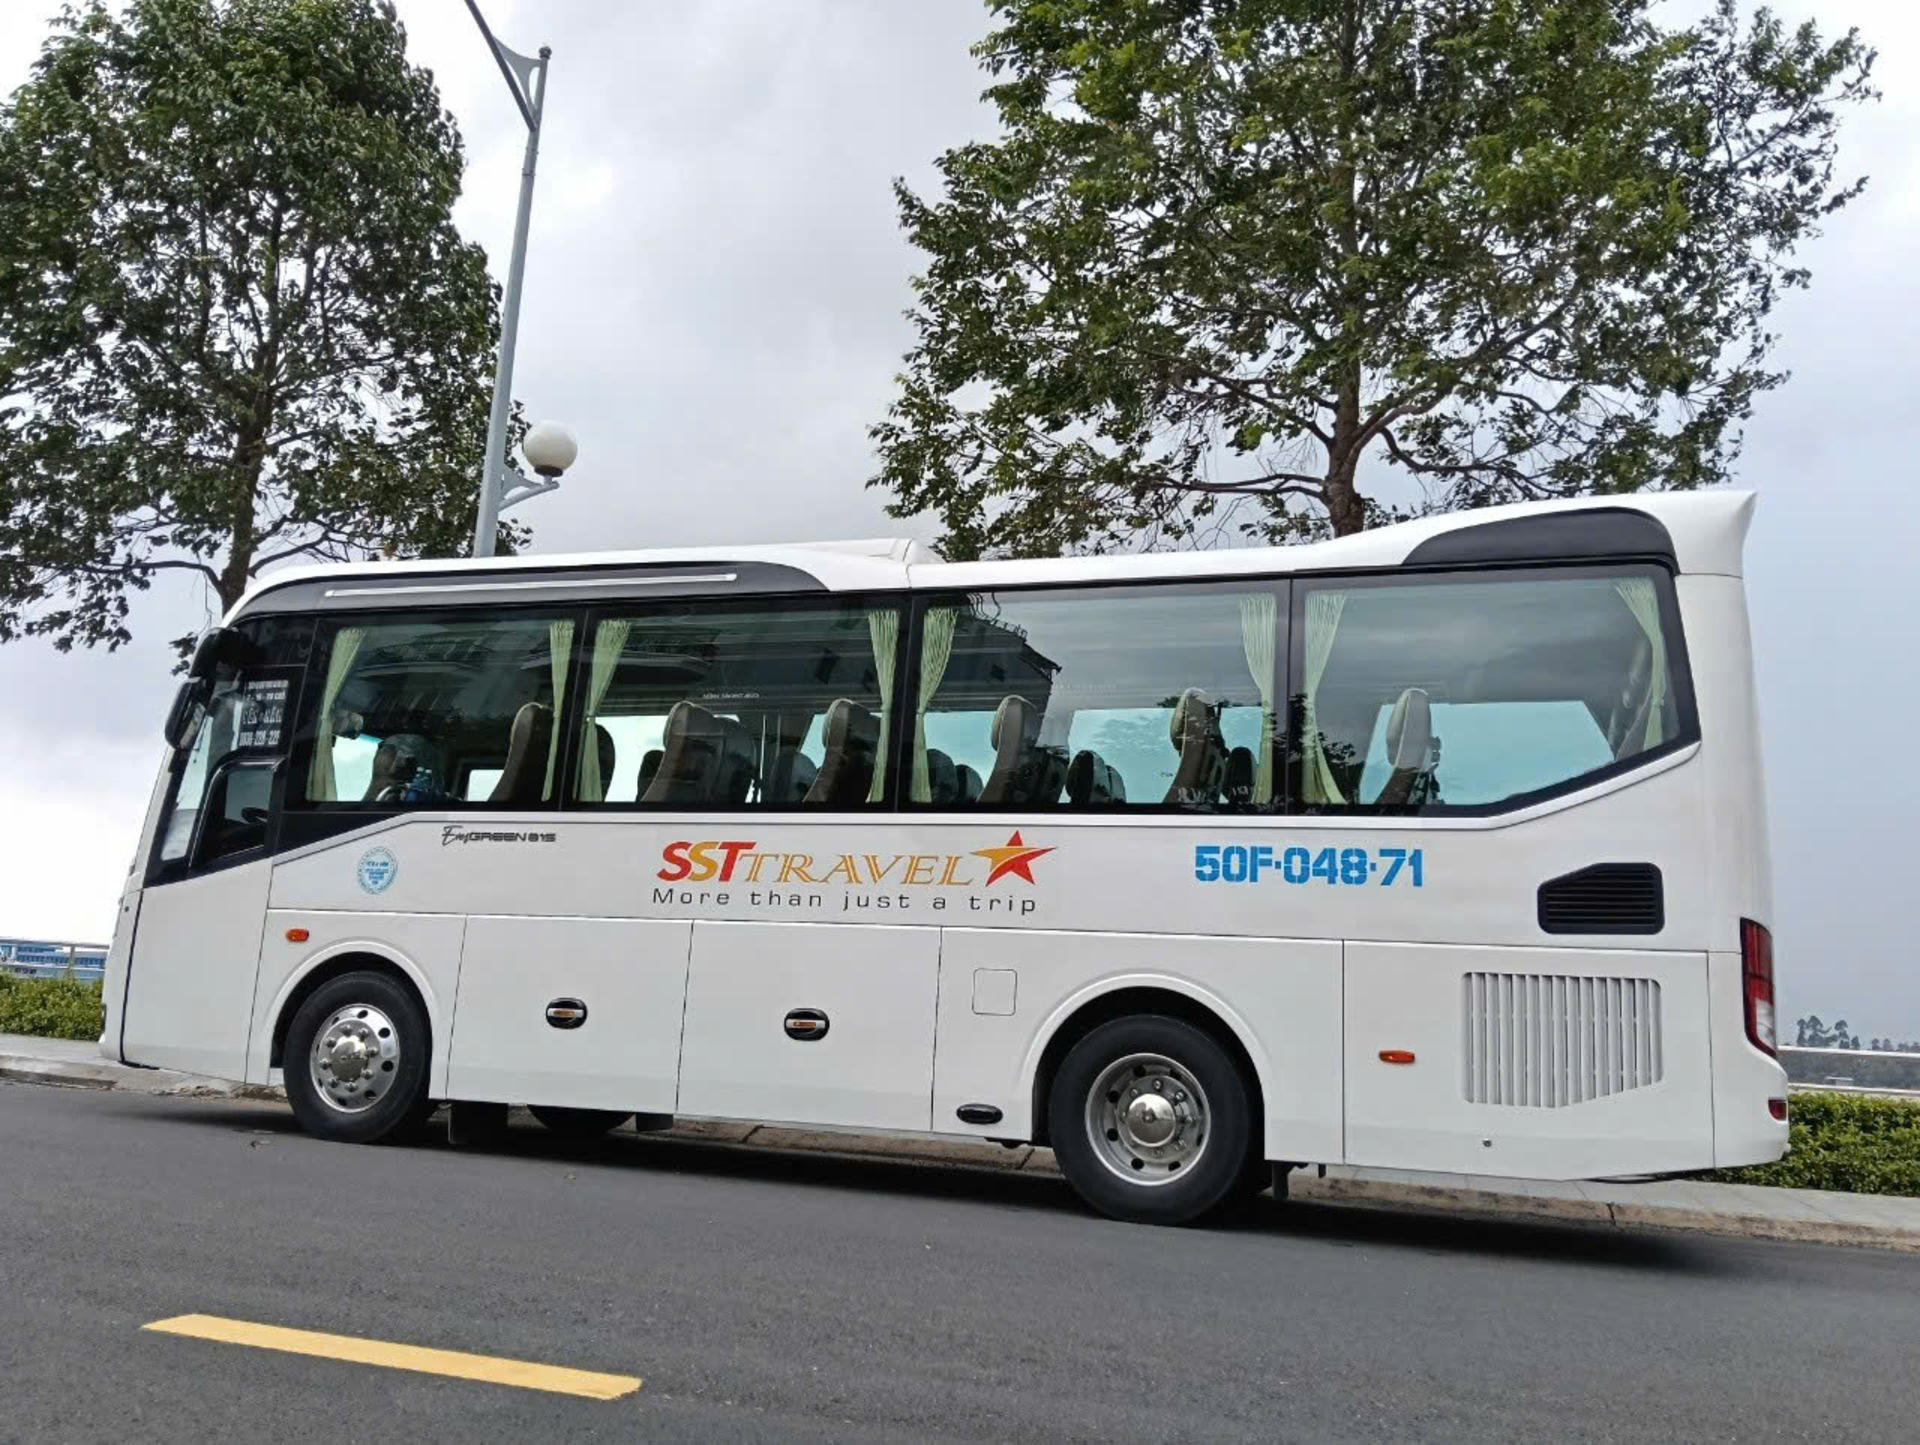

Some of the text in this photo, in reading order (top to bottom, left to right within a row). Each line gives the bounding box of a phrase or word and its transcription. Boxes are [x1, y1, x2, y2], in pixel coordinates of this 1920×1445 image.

[653, 888, 1036, 916] More than just a trip
